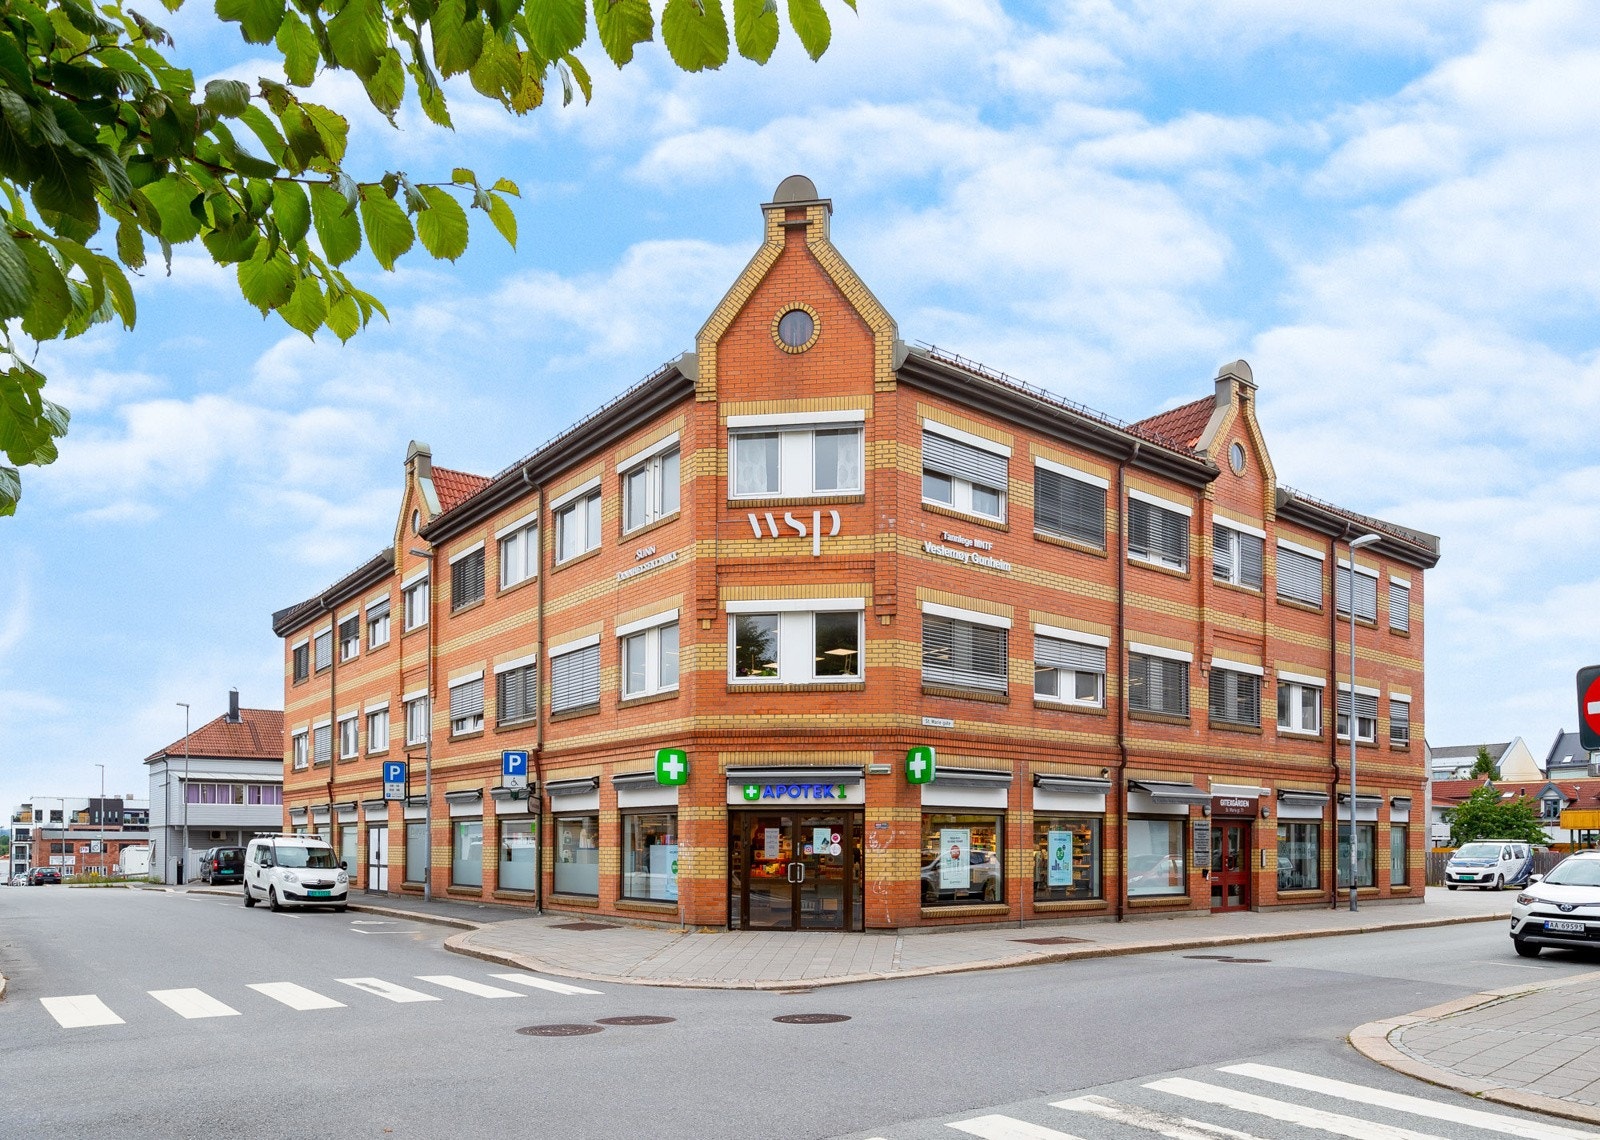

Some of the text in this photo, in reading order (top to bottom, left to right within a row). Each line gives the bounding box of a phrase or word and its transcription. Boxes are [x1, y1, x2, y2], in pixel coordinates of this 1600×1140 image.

[942, 531, 973, 548] Tannlege
[924, 541, 1011, 572] Veslemøy Gunheim
[509, 755, 521, 773] P
[389, 765, 401, 781] P
[762, 784, 847, 799] APOTEK 1
[1561, 922, 1583, 931] 69595
